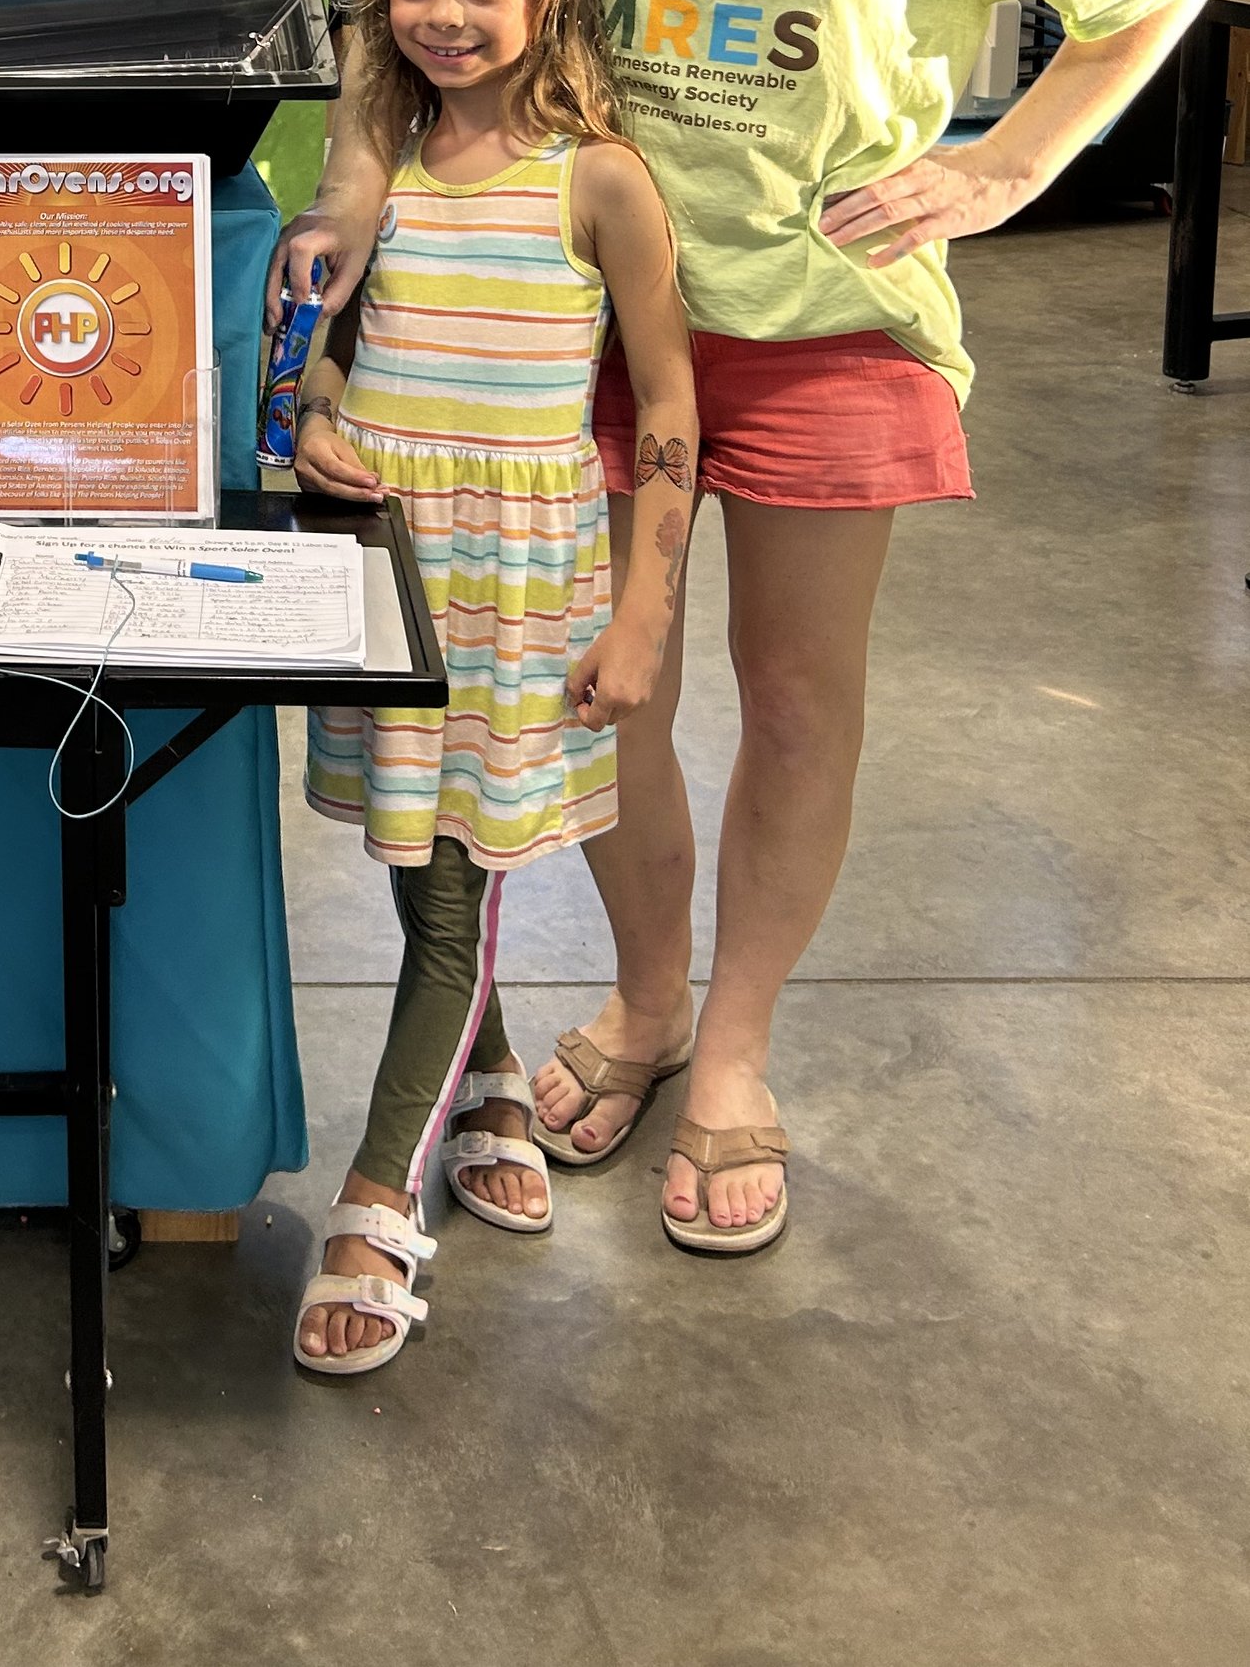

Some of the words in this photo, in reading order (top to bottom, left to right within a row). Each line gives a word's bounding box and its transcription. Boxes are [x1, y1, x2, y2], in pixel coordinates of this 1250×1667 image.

[612, 55, 681, 77] nnesota
[686, 64, 797, 91] Renewable
[684, 86, 758, 112] Society
[40, 212, 54, 220] Our
[55, 212, 88, 220] Mission:
[35, 311, 99, 343] PHP
[198, 545, 229, 553] Sport
